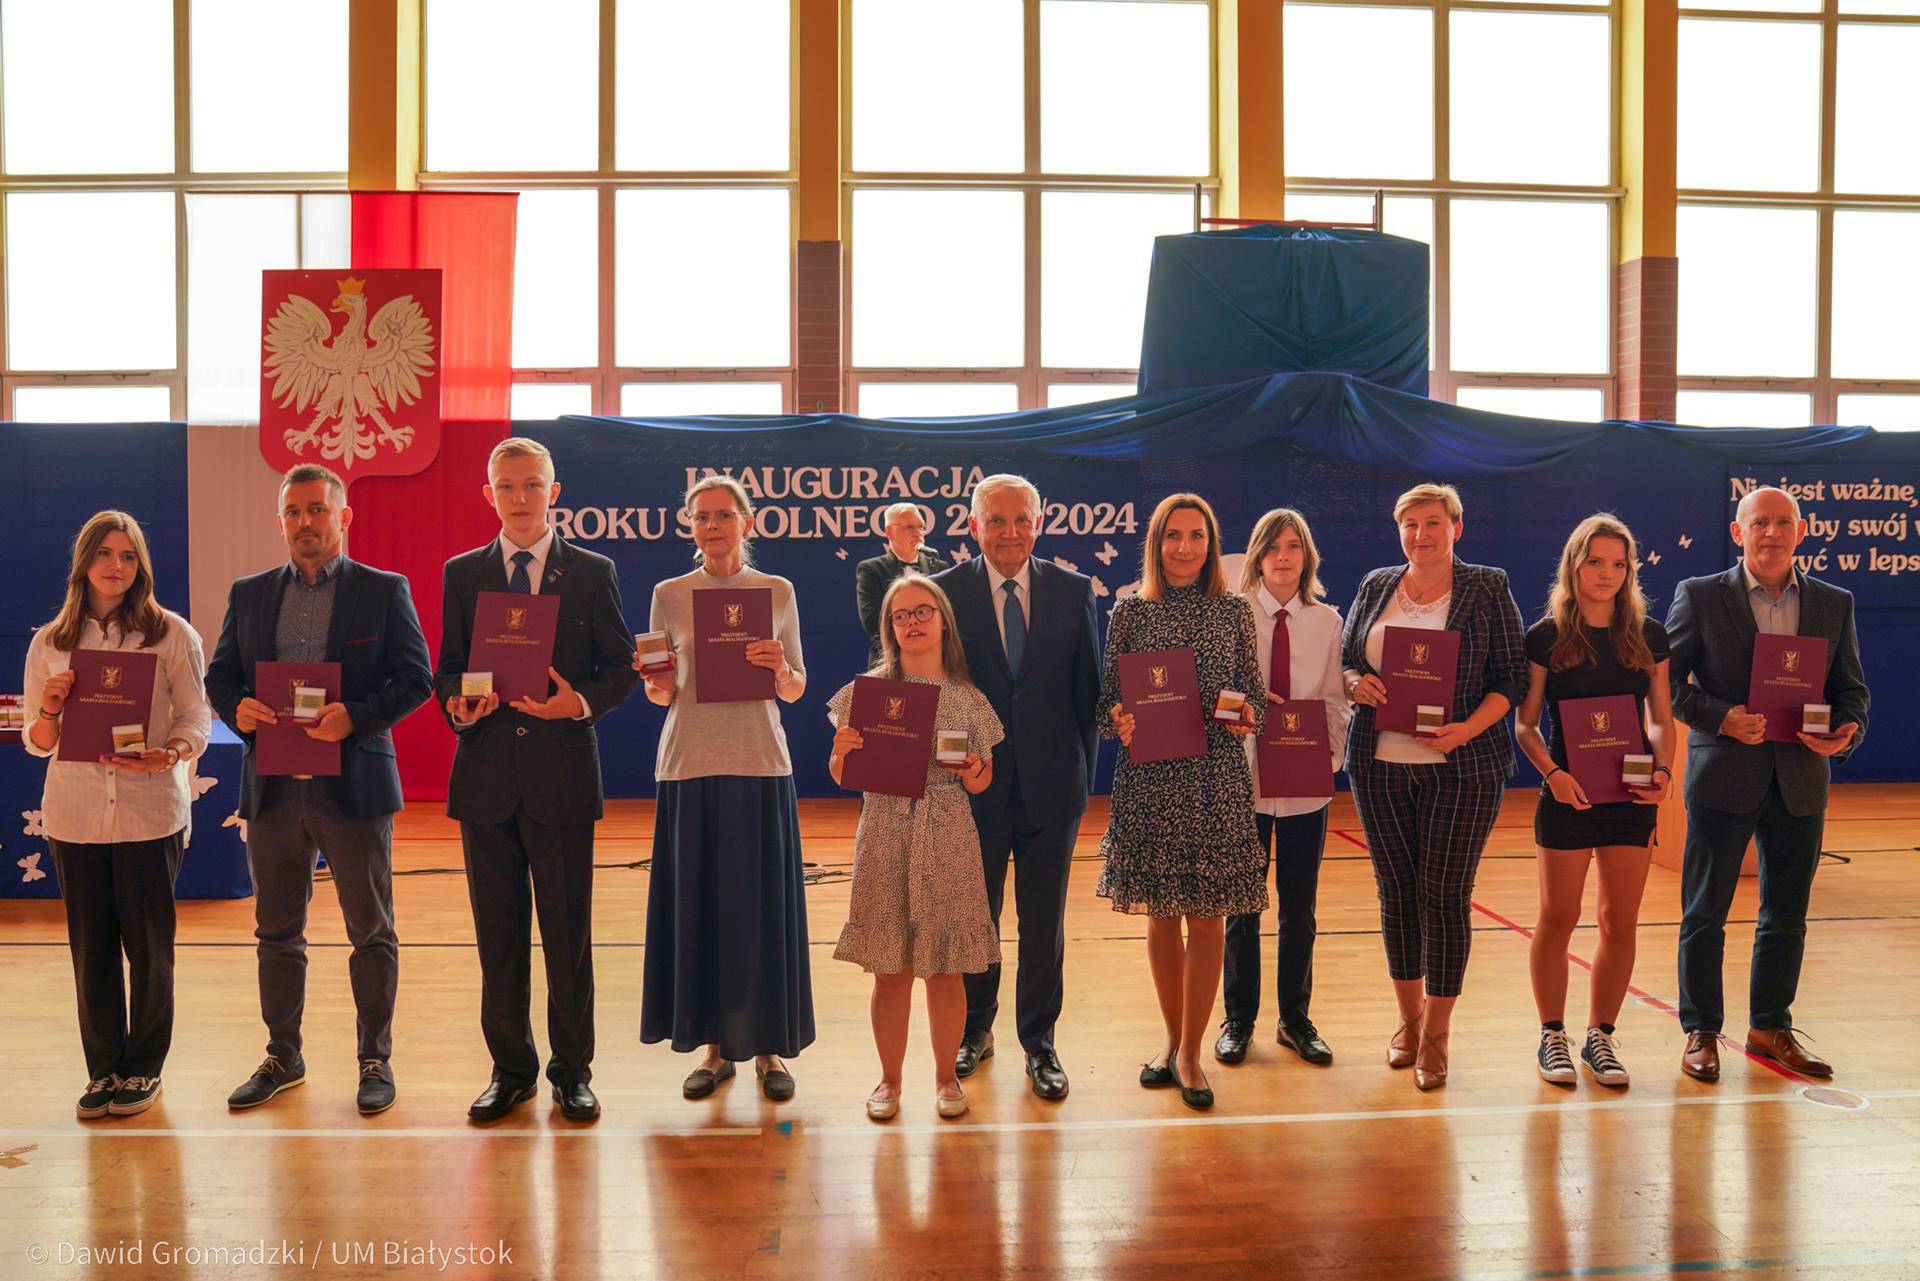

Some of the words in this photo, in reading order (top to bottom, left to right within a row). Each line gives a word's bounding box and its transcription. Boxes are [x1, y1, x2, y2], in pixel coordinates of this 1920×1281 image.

[1831, 477, 1919, 508] ważne,
[549, 506, 667, 540] ROKU
[946, 497, 1139, 536] 2/2024
[1848, 512, 1907, 542] swój
[1837, 554, 1861, 571] w
